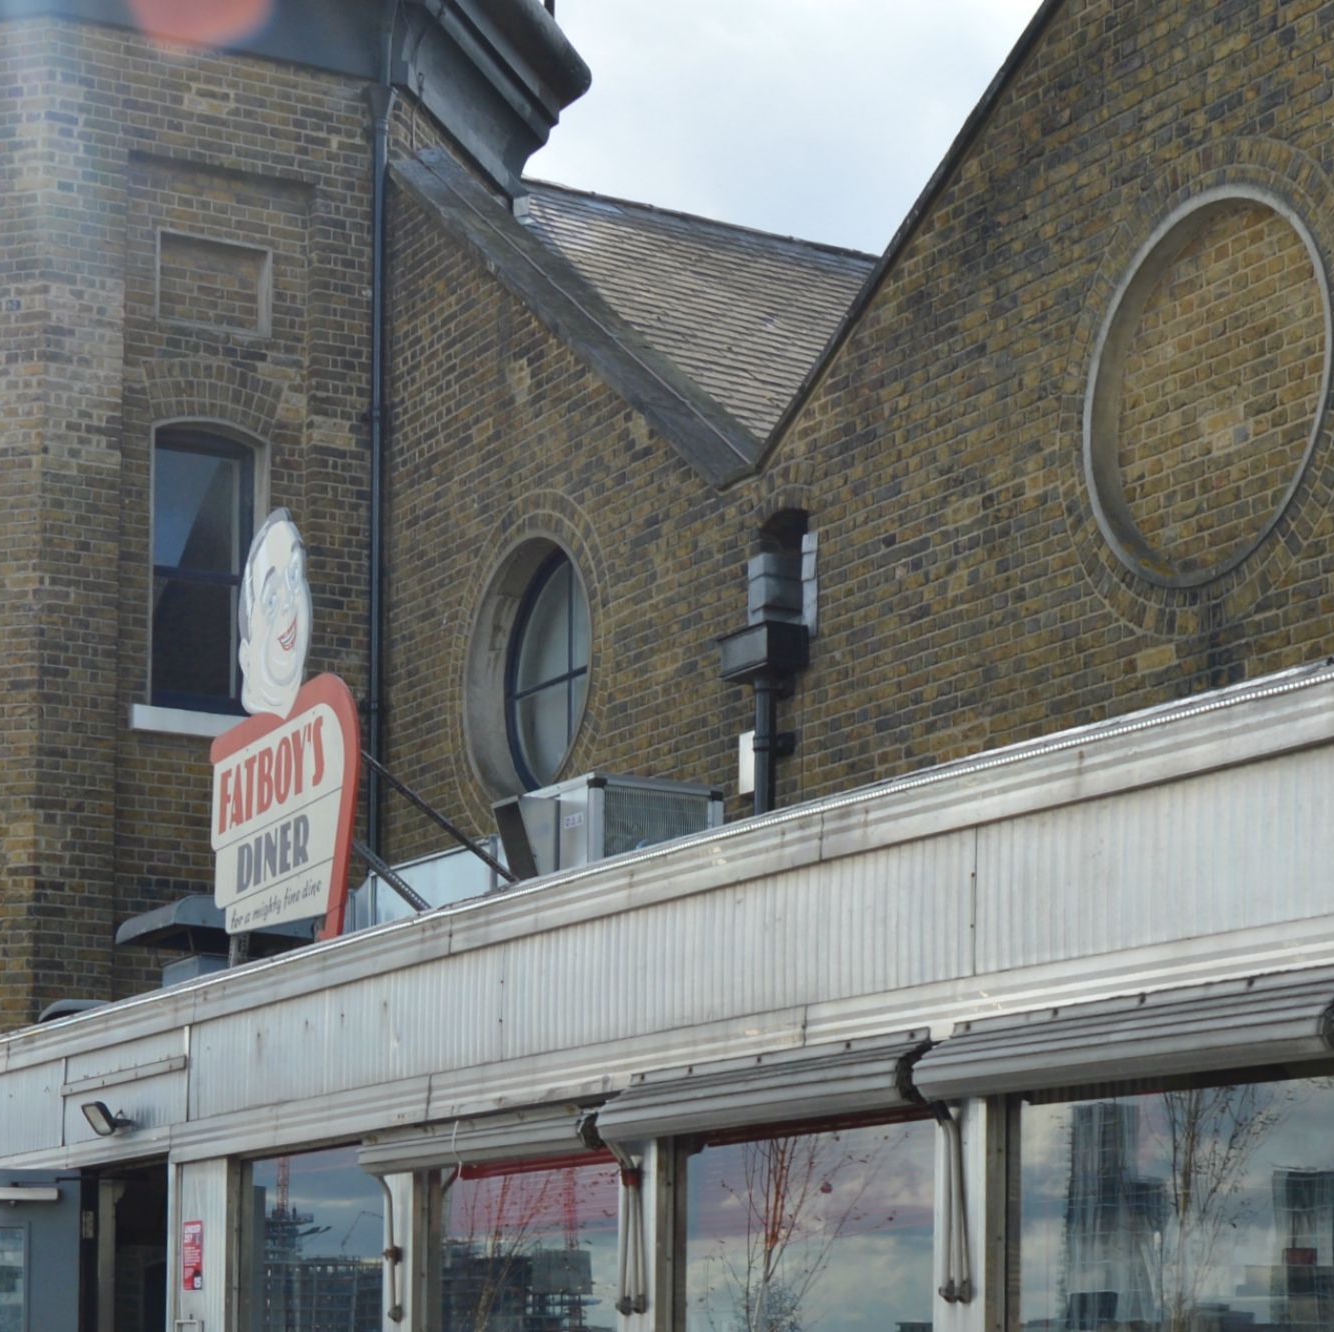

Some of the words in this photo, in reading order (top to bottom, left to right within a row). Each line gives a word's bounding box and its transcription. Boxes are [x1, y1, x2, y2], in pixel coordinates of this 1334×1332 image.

[218, 716, 325, 835] FATBOY'S
[236, 813, 309, 894] DINER
[231, 908, 243, 929] for
[244, 913, 250, 924] a
[252, 895, 281, 920] mighty
[284, 888, 300, 909] fine
[302, 878, 321, 899] dine
